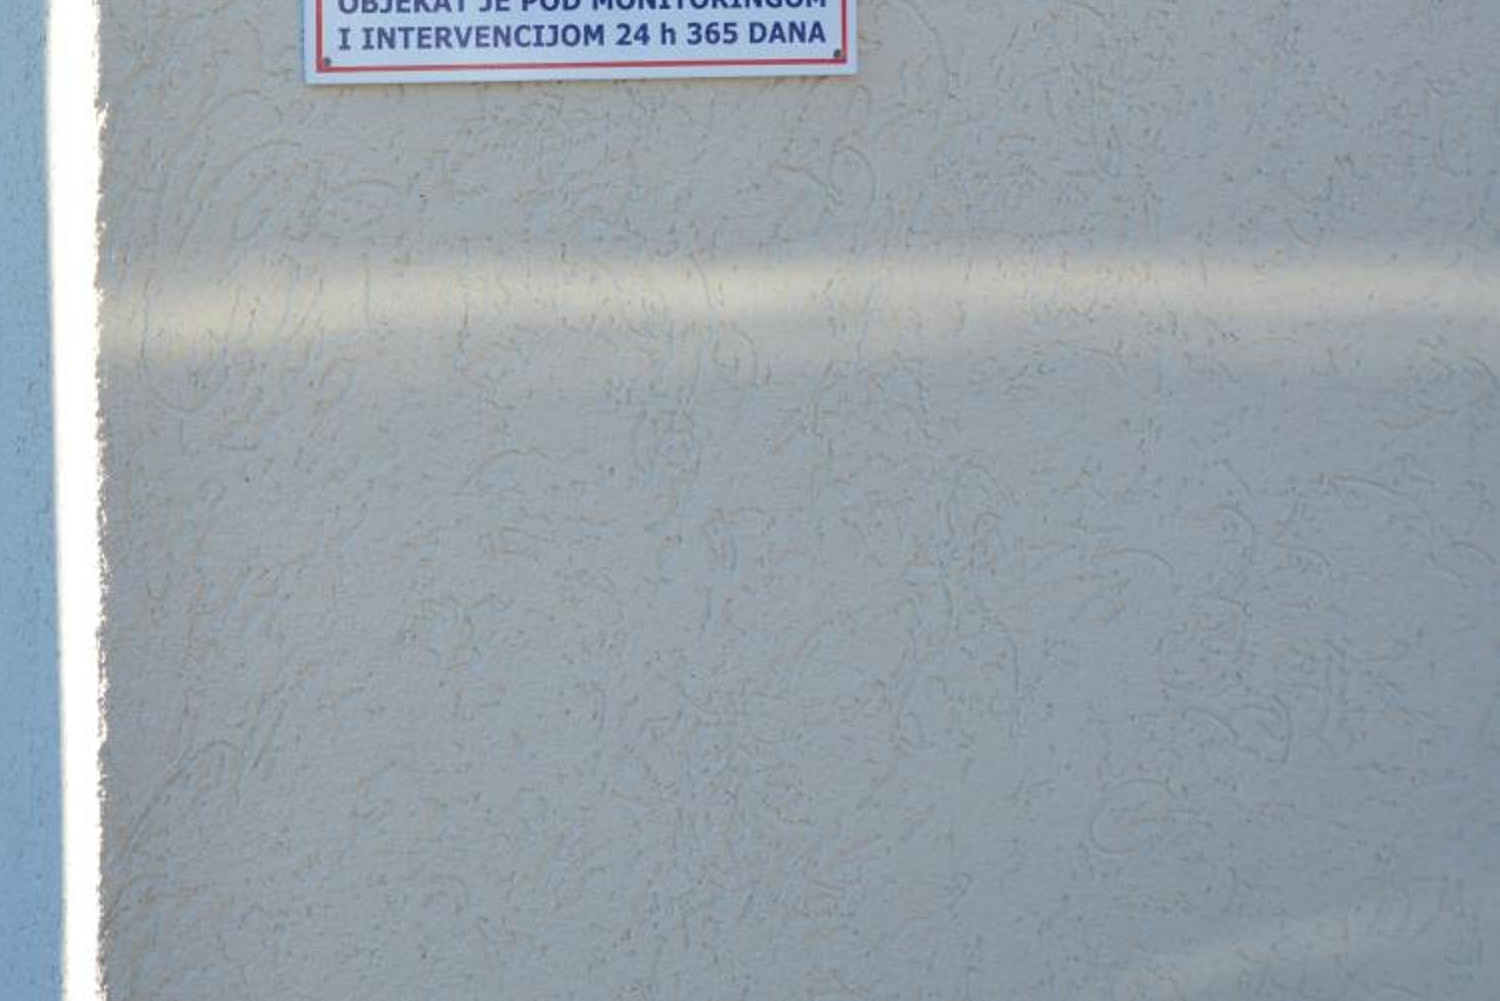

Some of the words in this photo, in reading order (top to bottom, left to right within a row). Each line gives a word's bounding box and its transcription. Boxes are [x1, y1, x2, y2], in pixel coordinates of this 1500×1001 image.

[338, 28, 351, 50] I
[362, 24, 605, 50] INTERVENCIJOM
[616, 24, 650, 47] 24
[660, 23, 676, 46] h
[686, 22, 738, 45] 365
[749, 21, 826, 45] DANA
